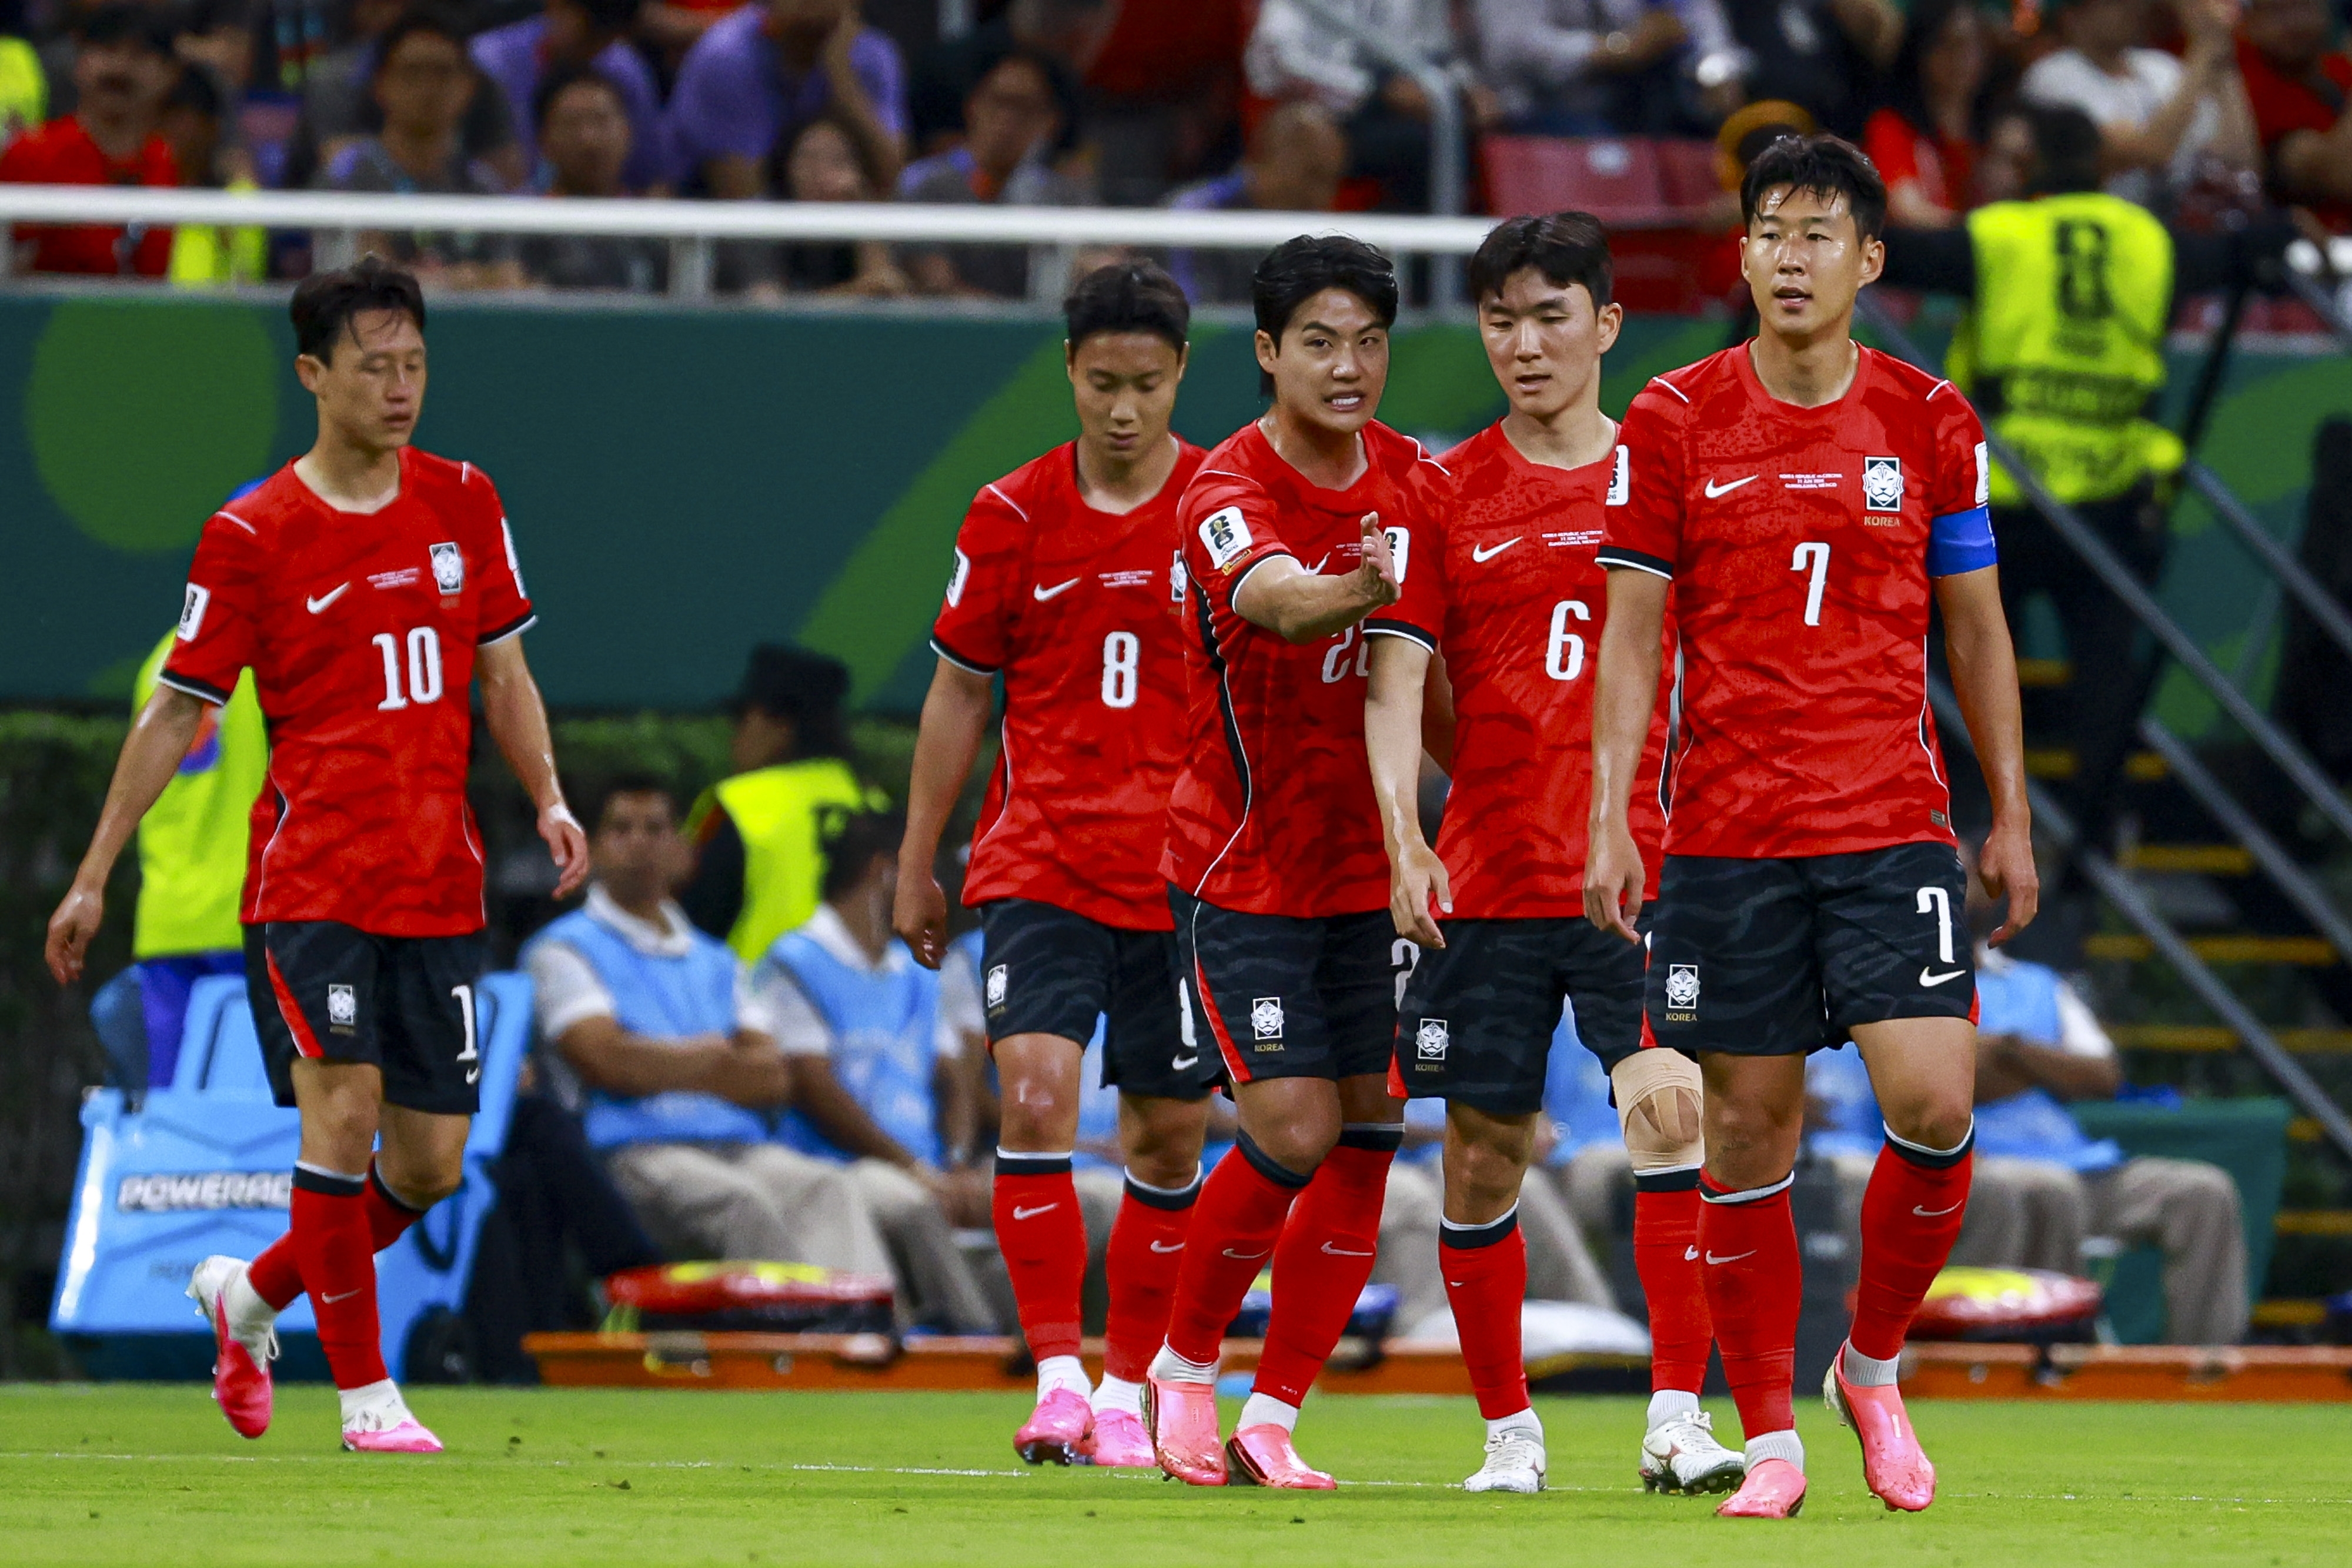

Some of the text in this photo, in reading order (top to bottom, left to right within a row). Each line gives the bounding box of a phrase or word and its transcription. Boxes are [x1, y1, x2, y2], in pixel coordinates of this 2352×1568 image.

[1864, 516, 1900, 527] KOREA
[1790, 542, 1830, 626] 7
[372, 626, 443, 711] 10
[1101, 631, 1139, 708] 8
[1545, 600, 1591, 681] 6
[1916, 887, 1955, 964] 7
[451, 985, 478, 1061] 1
[1254, 1044, 1285, 1052] KOREA
[1666, 1012, 1698, 1022] KOREA
